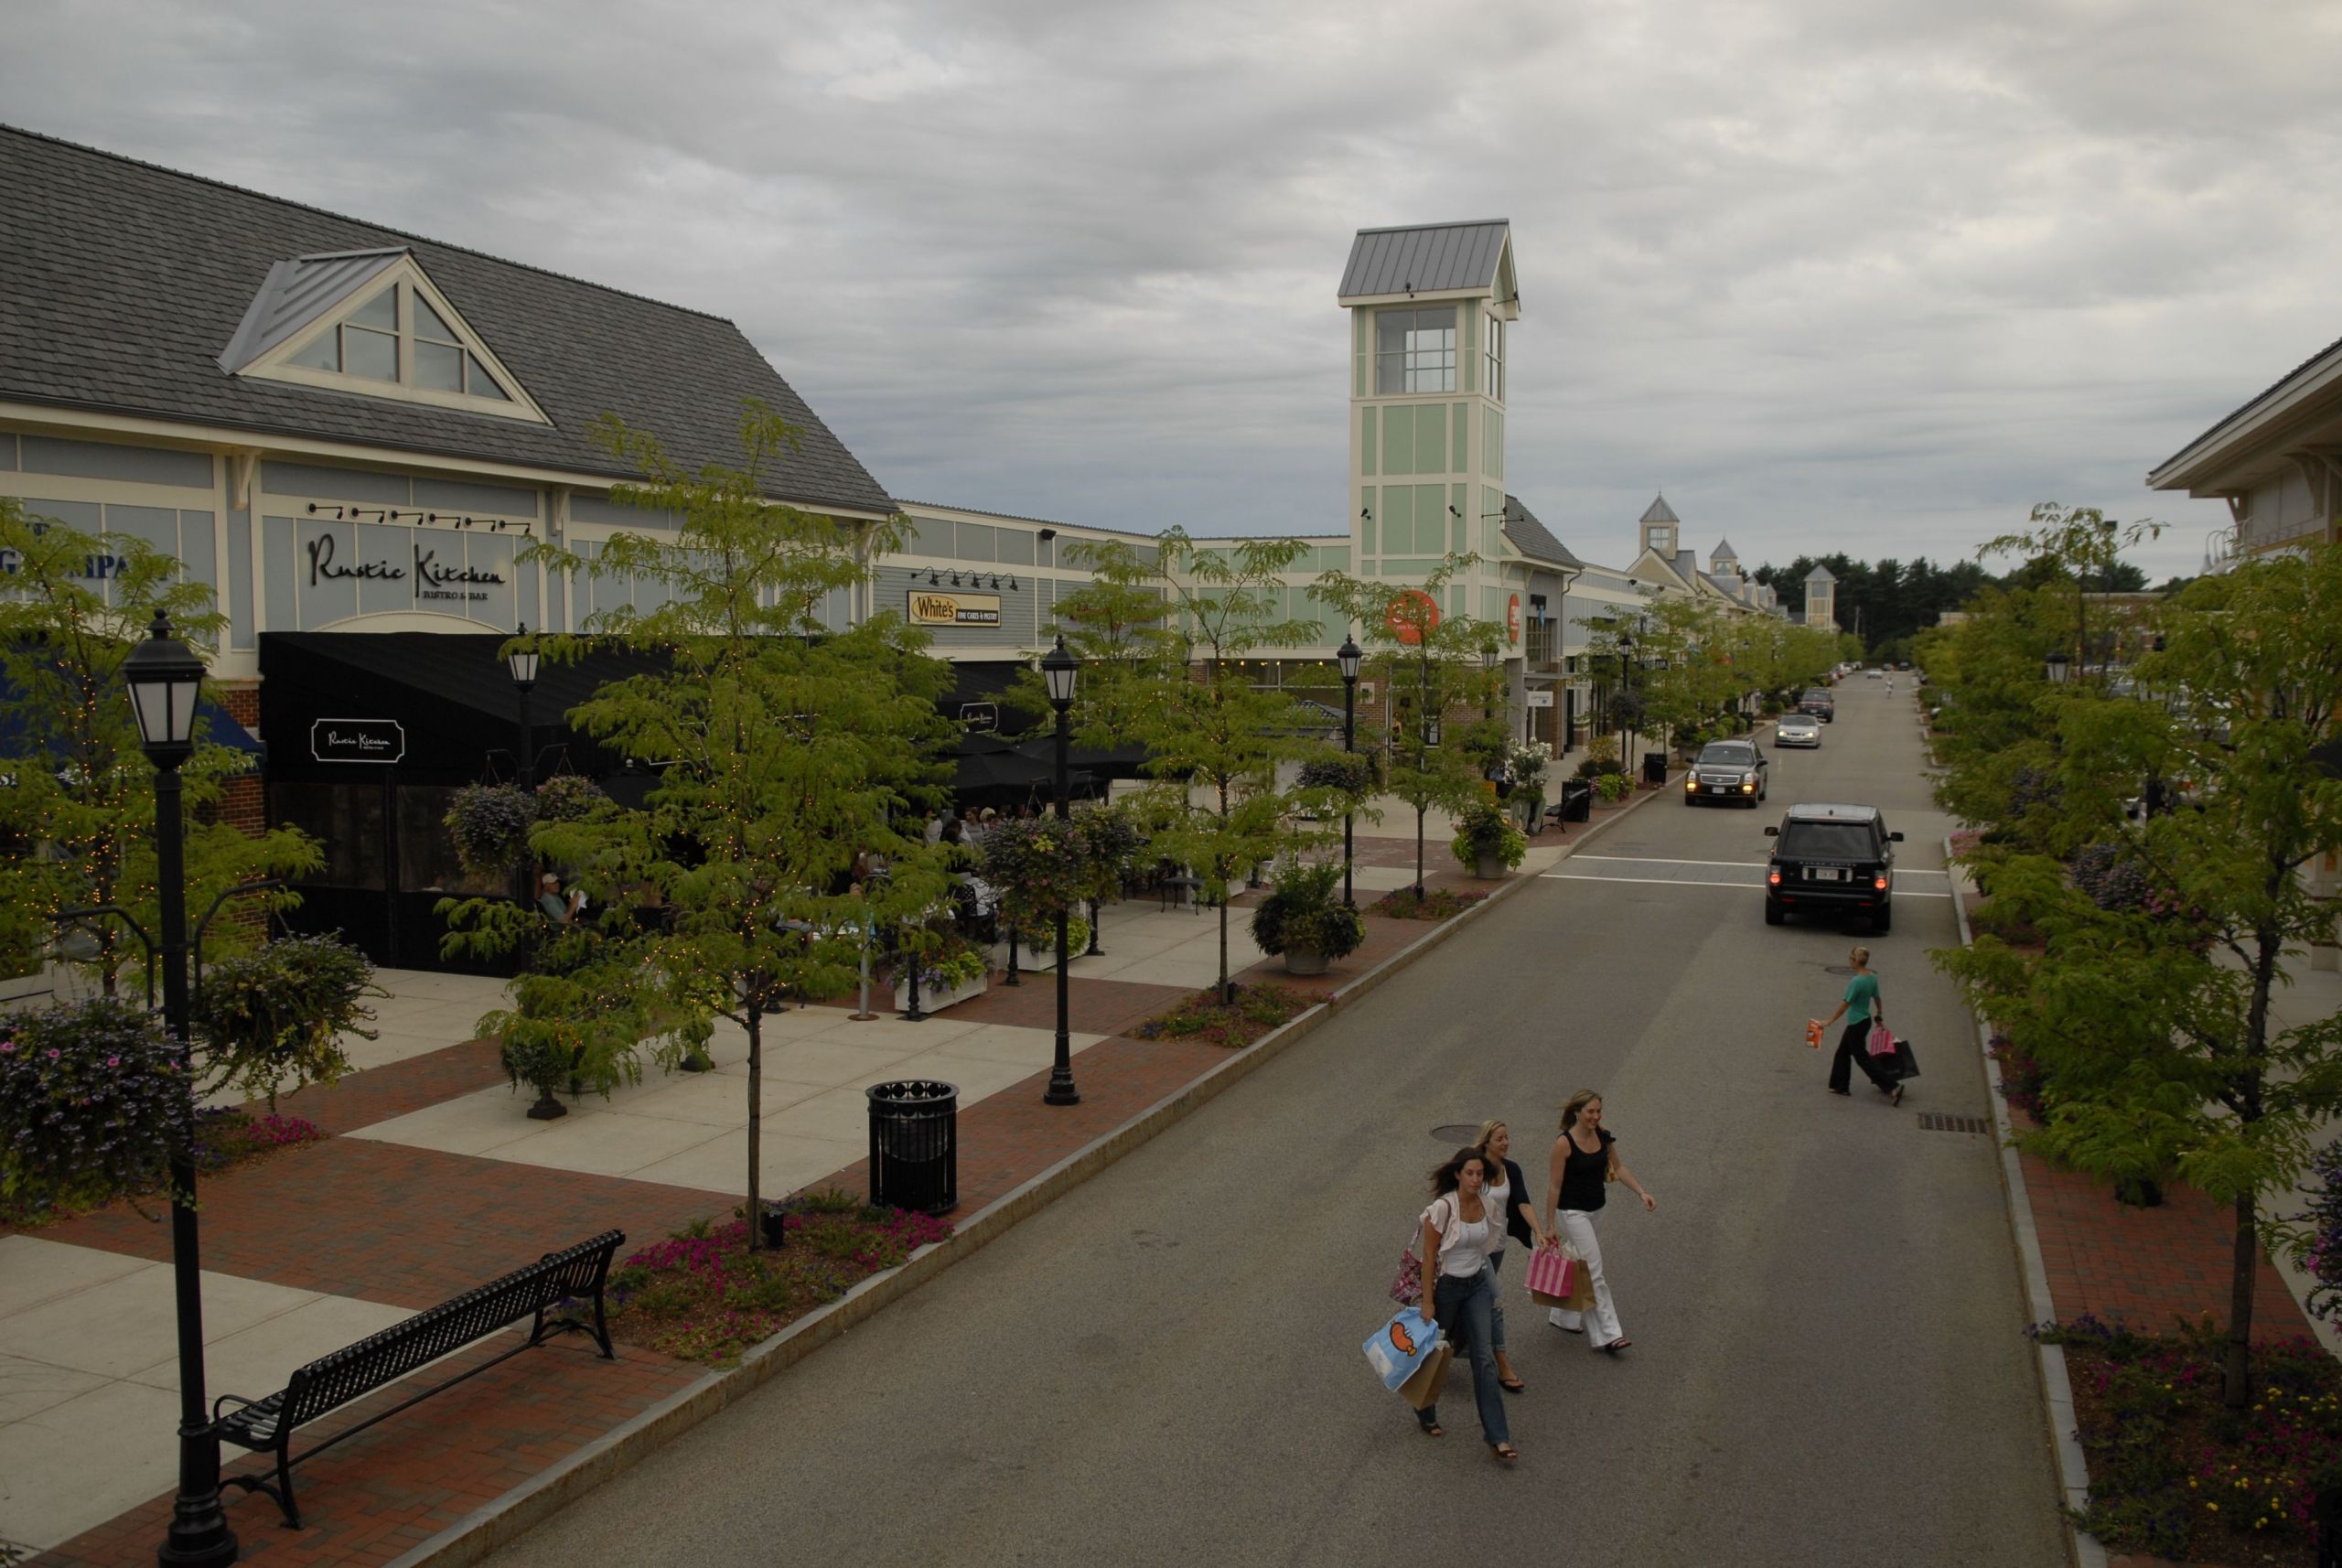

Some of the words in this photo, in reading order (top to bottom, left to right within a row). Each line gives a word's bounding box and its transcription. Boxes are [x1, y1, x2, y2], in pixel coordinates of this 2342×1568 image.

[307, 533, 406, 585] Rustic
[414, 543, 505, 597] Kitchen
[424, 591, 457, 599] BISTRO
[468, 592, 488, 600] BAR
[918, 596, 953, 618] White's
